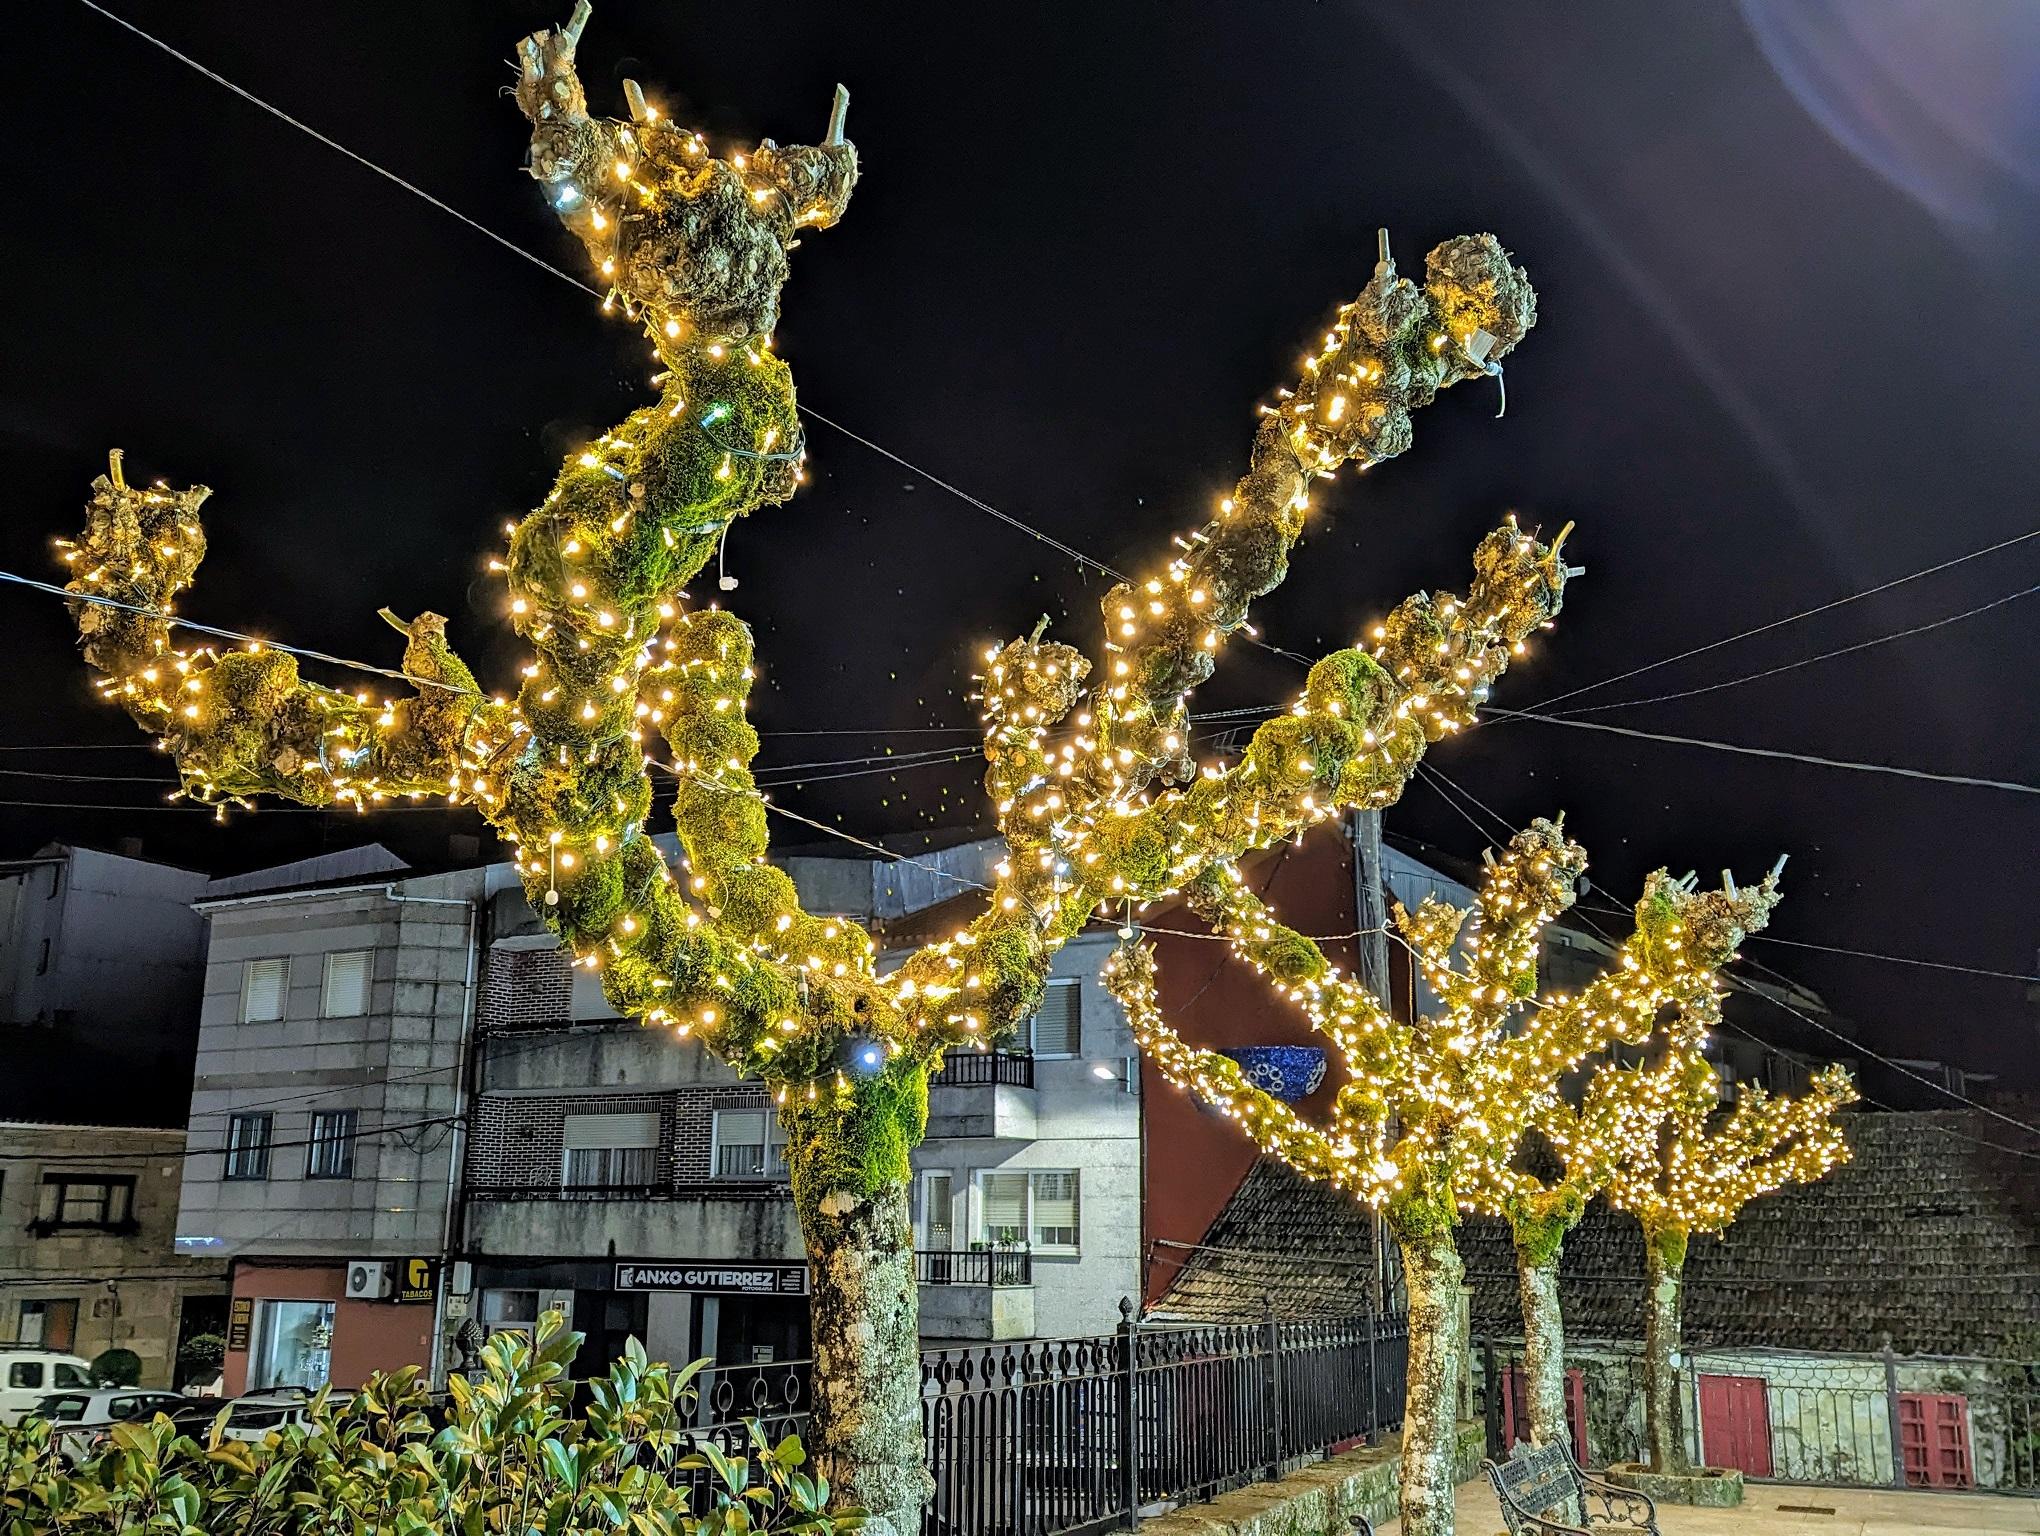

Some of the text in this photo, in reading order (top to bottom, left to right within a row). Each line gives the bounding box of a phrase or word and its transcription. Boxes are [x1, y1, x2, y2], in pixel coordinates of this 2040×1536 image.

[635, 1270, 682, 1285] ANXO
[684, 1270, 774, 1286] GUTIERREZ
[401, 1289, 433, 1299] TABACOS
